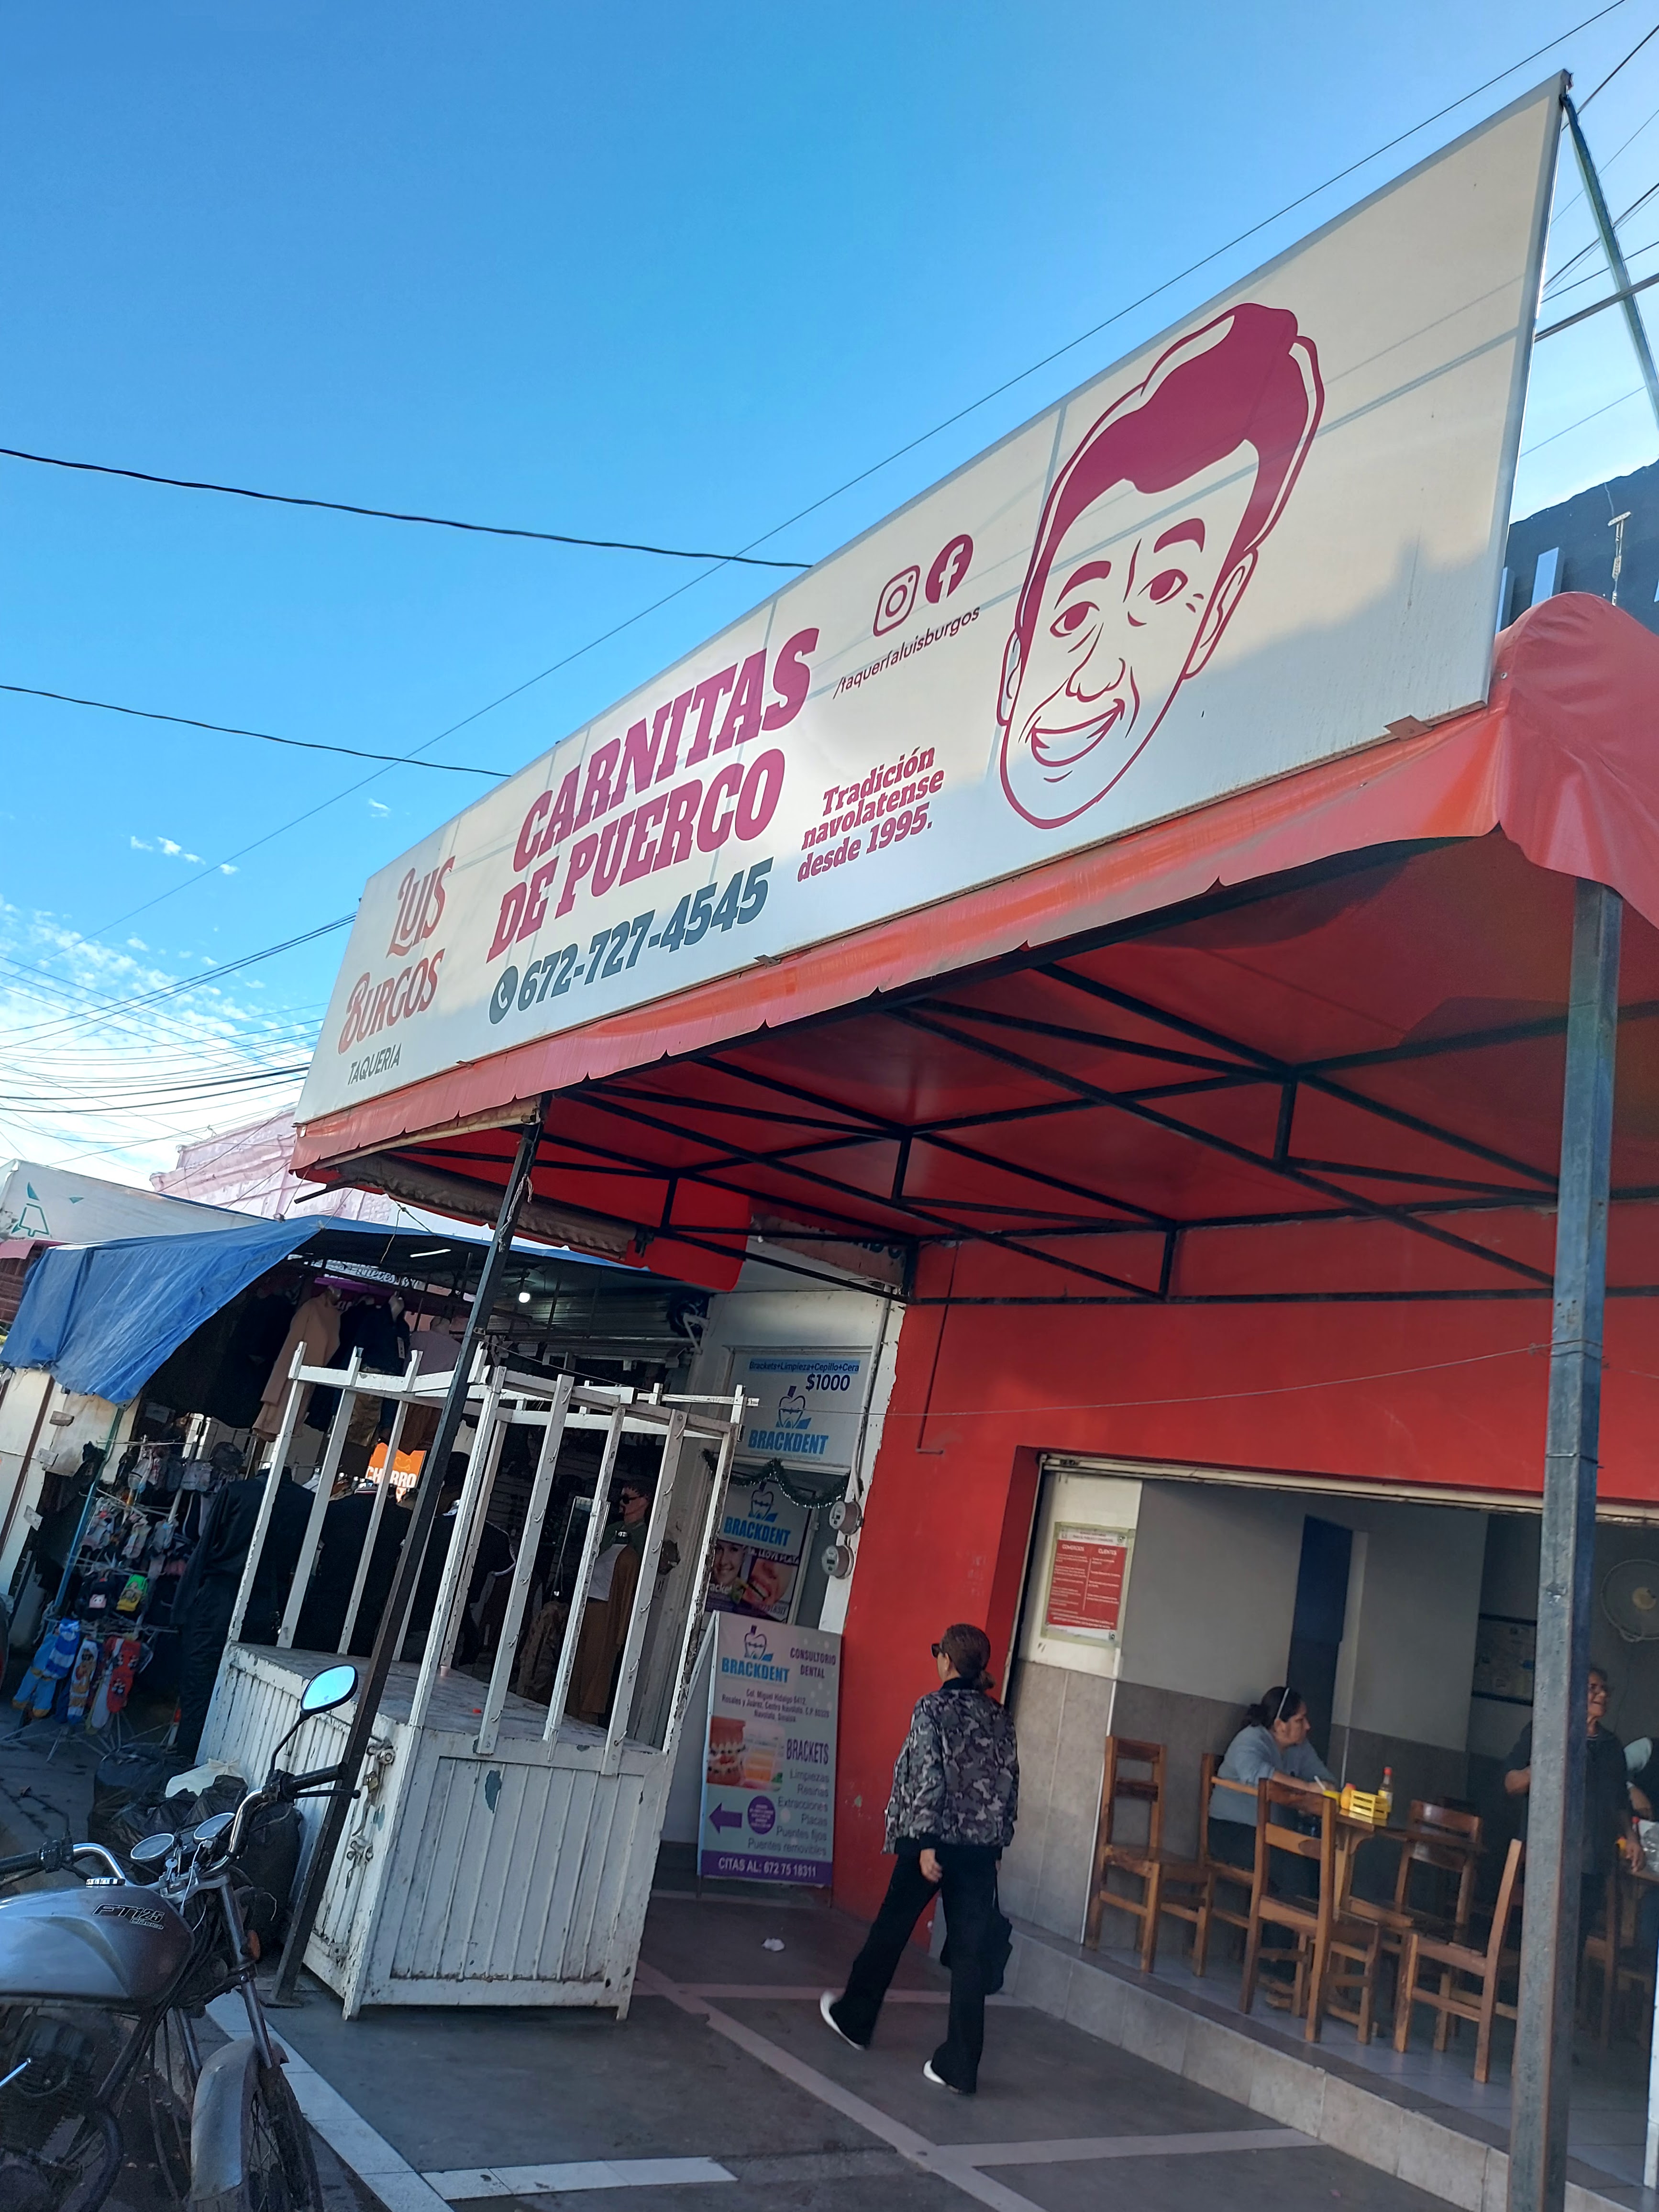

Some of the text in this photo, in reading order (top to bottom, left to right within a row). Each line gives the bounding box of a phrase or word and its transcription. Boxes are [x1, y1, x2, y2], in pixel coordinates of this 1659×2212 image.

[513, 627, 819, 873] CARNITAS
[823, 746, 935, 816] Tradición
[801, 770, 944, 851] navolatense
[797, 802, 933, 882] desde 1995.
[486, 749, 785, 963] DE PUERCO
[387, 856, 455, 958] LUIS
[518, 857, 774, 1011] 672-727-4545
[338, 948, 445, 1054] BURGOS
[348, 1043, 401, 1085] TAQUERIA
[805, 1373, 851, 1392] $1000
[748, 1429, 829, 1454] BRACKDENT
[365, 1466, 417, 1488] CHRRO
[724, 1516, 791, 1546] BRACKDENT
[722, 1657, 790, 1683] BRACKDENT
[790, 1648, 836, 1665] CONSULTORIO
[800, 1665, 825, 1679] DENTAL
[786, 1738, 829, 1765] BRACKETS
[748, 1837, 781, 1851] Puentes
[776, 1825, 809, 1839] Puentes
[719, 1857, 745, 1871] CITAS
[764, 1861, 779, 1874] 672
[92, 1903, 165, 1923] FT125
